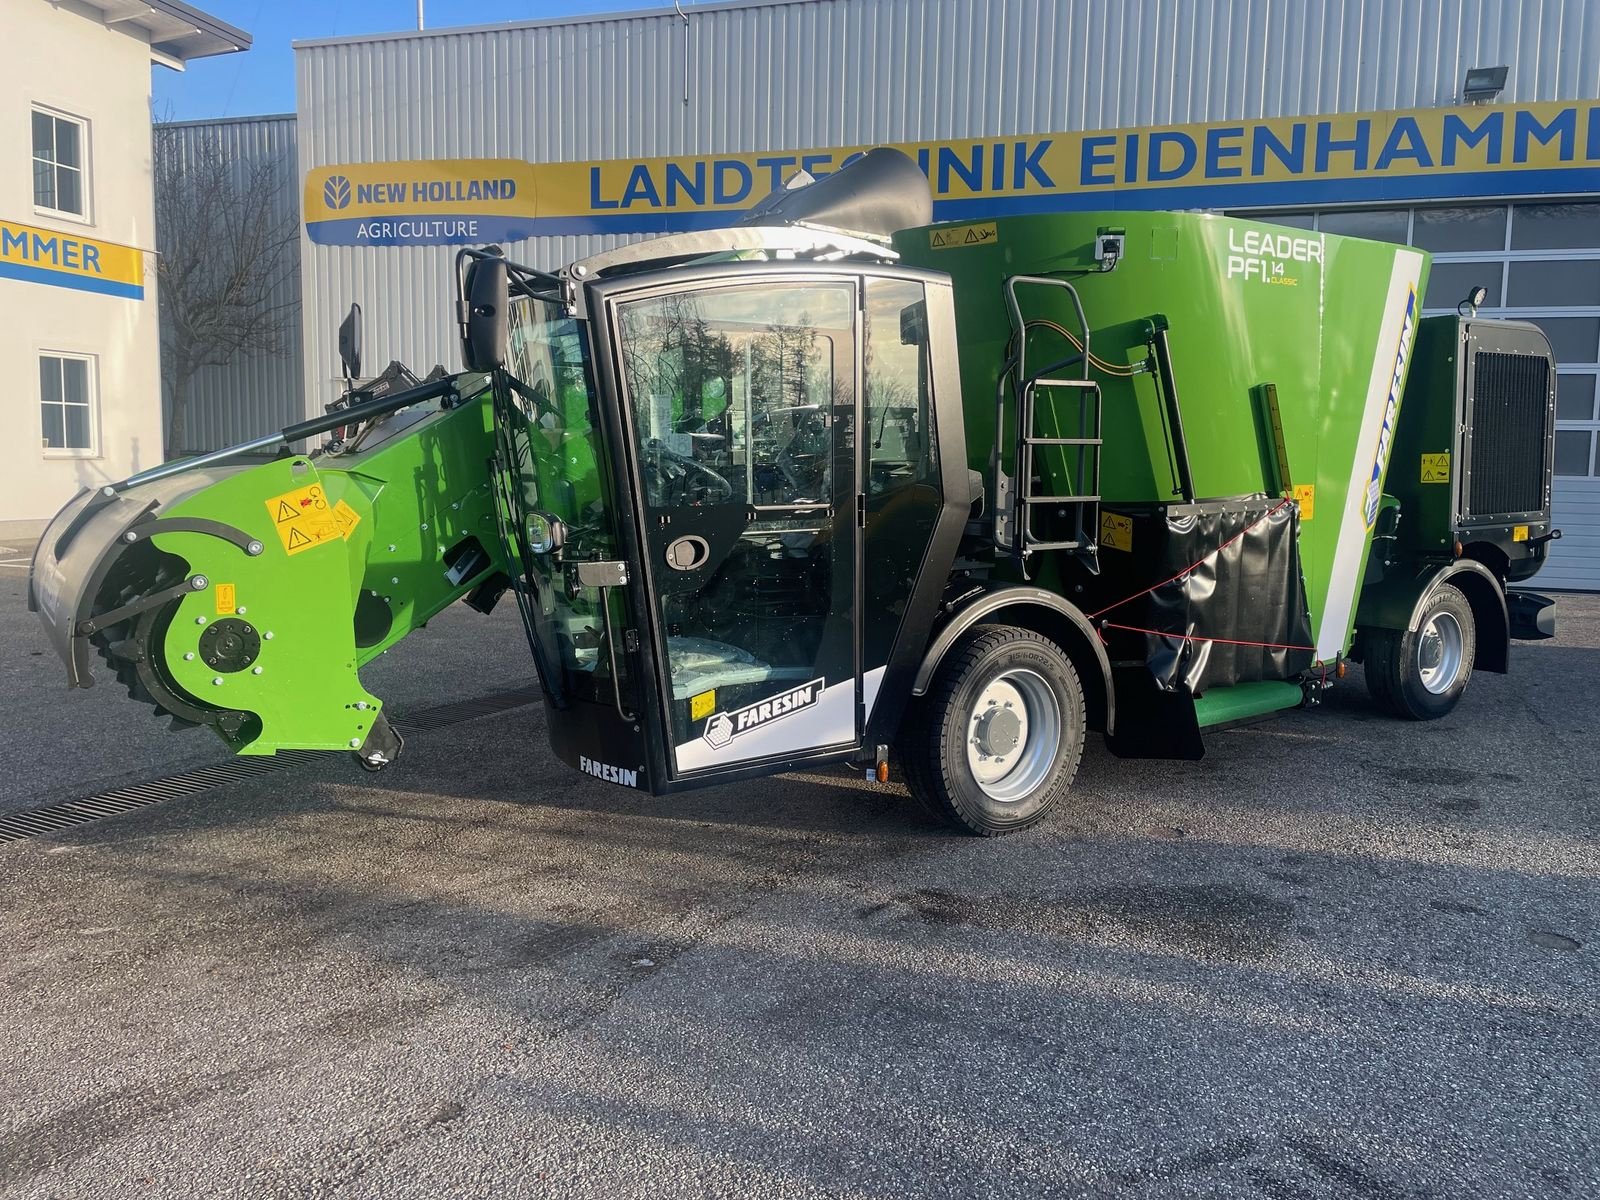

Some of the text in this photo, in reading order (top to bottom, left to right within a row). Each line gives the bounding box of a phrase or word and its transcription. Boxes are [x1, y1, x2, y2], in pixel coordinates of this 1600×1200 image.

[357, 179, 516, 204] NEW HOLLAND
[589, 139, 1056, 210] LANDTENIK
[356, 220, 478, 239] AGRICULTURE
[1228, 227, 1321, 264] LEADER
[1, 226, 102, 273] MMER
[1270, 276, 1298, 287] CLASSIC
[737, 685, 812, 731] FARESIN
[580, 755, 638, 788] FARESIN
